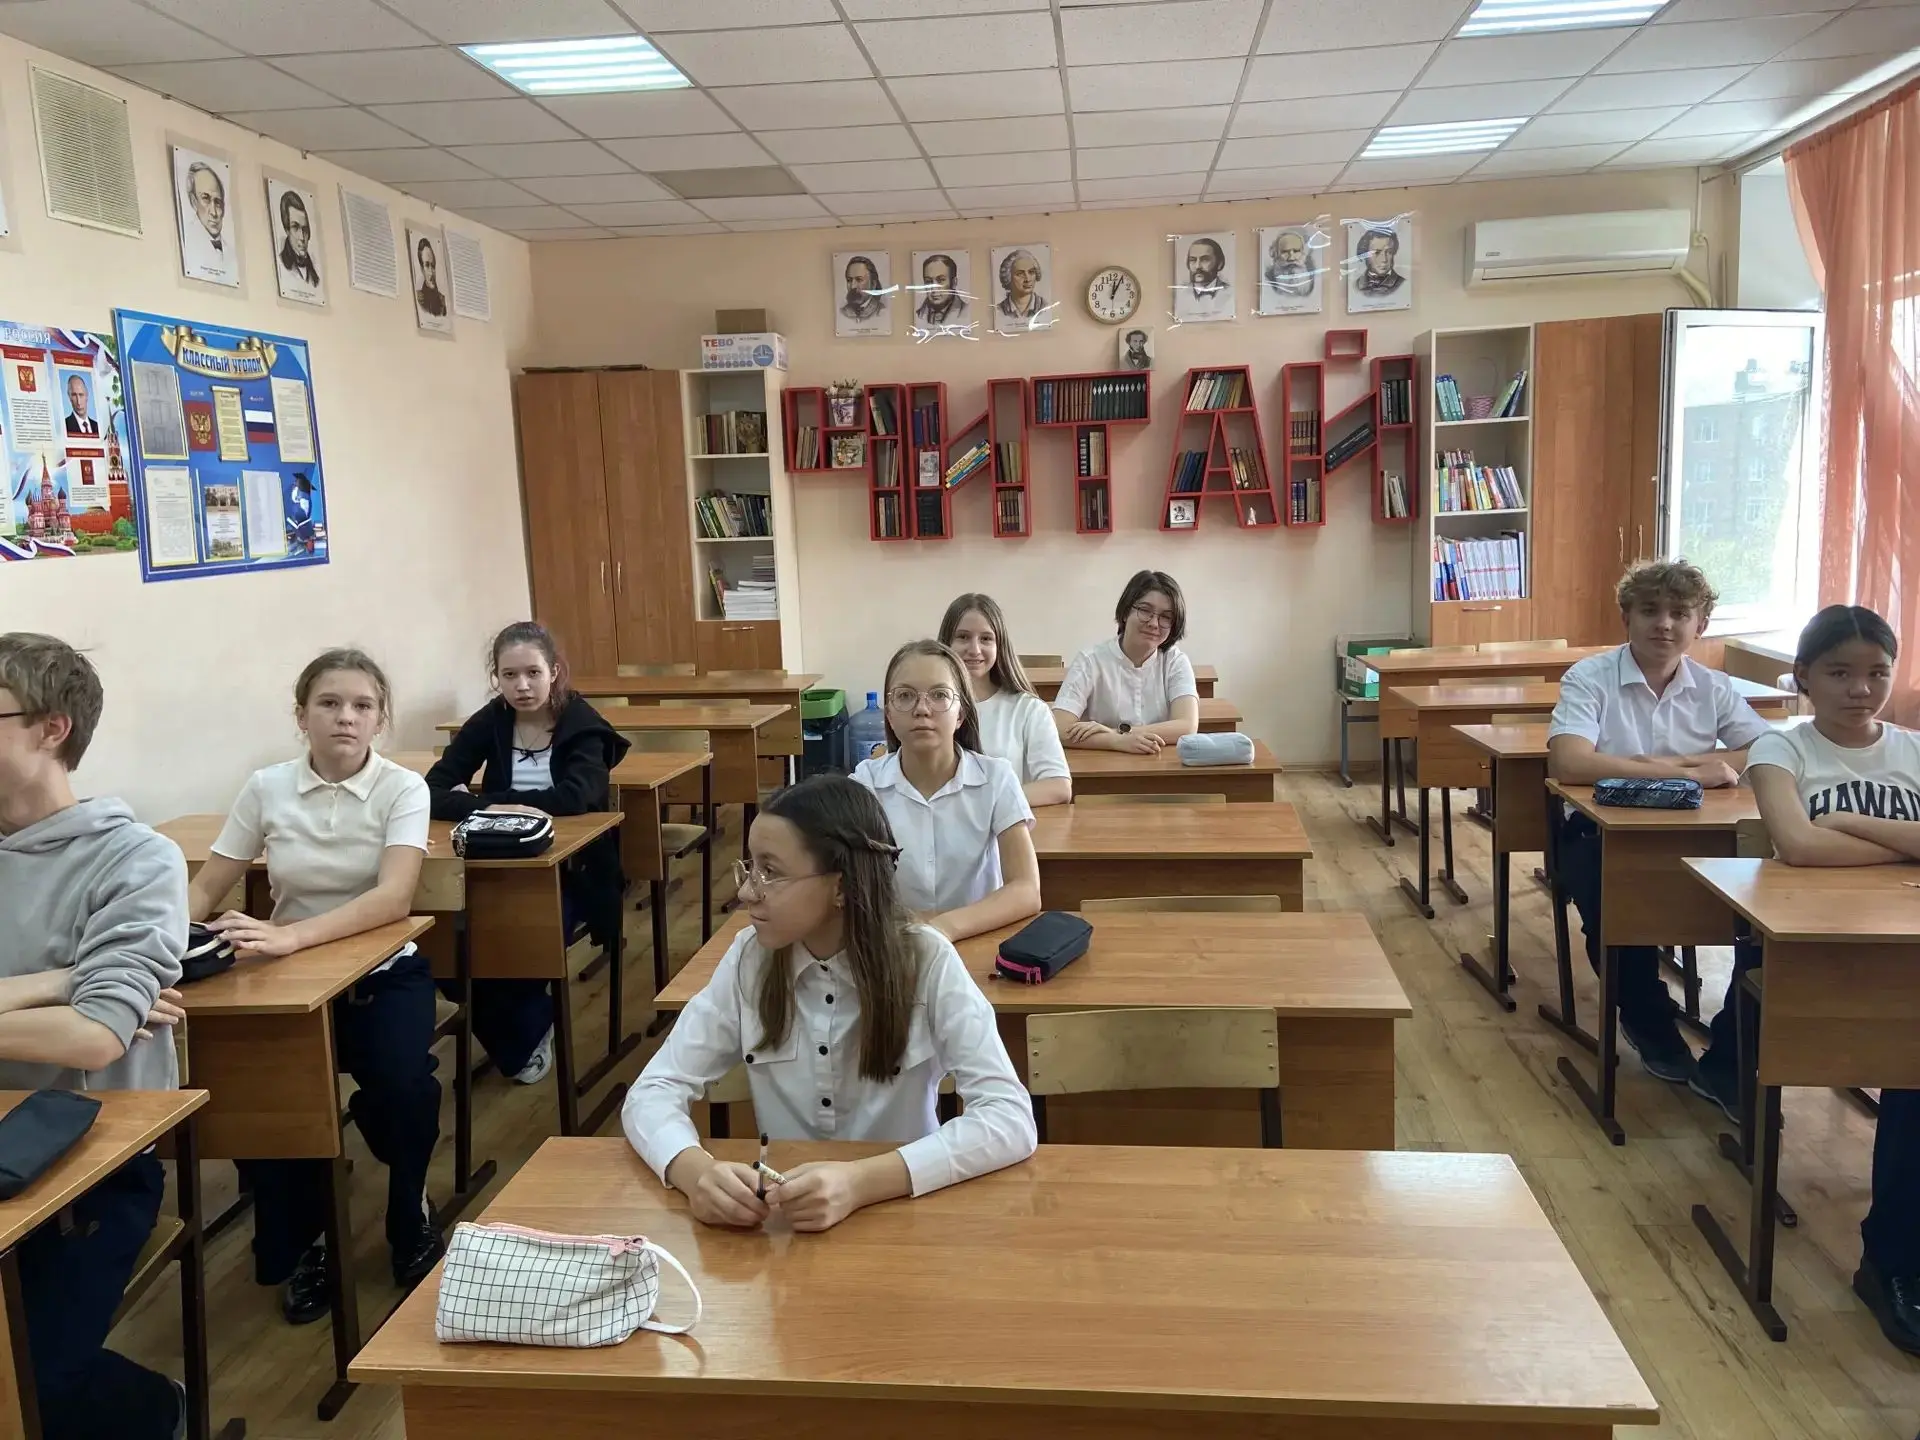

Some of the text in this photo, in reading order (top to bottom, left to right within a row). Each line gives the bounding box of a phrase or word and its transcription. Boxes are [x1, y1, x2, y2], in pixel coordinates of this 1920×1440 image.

[1109, 273, 1118, 281] 12
[1092, 292, 1097, 300] 9
[1129, 291, 1135, 299] 3
[4, 327, 51, 345] РОССИЯ
[182, 346, 264, 373] КЛАССНЫЙ УГОЛОК
[783, 329, 1420, 543] ЧИТАЙ
